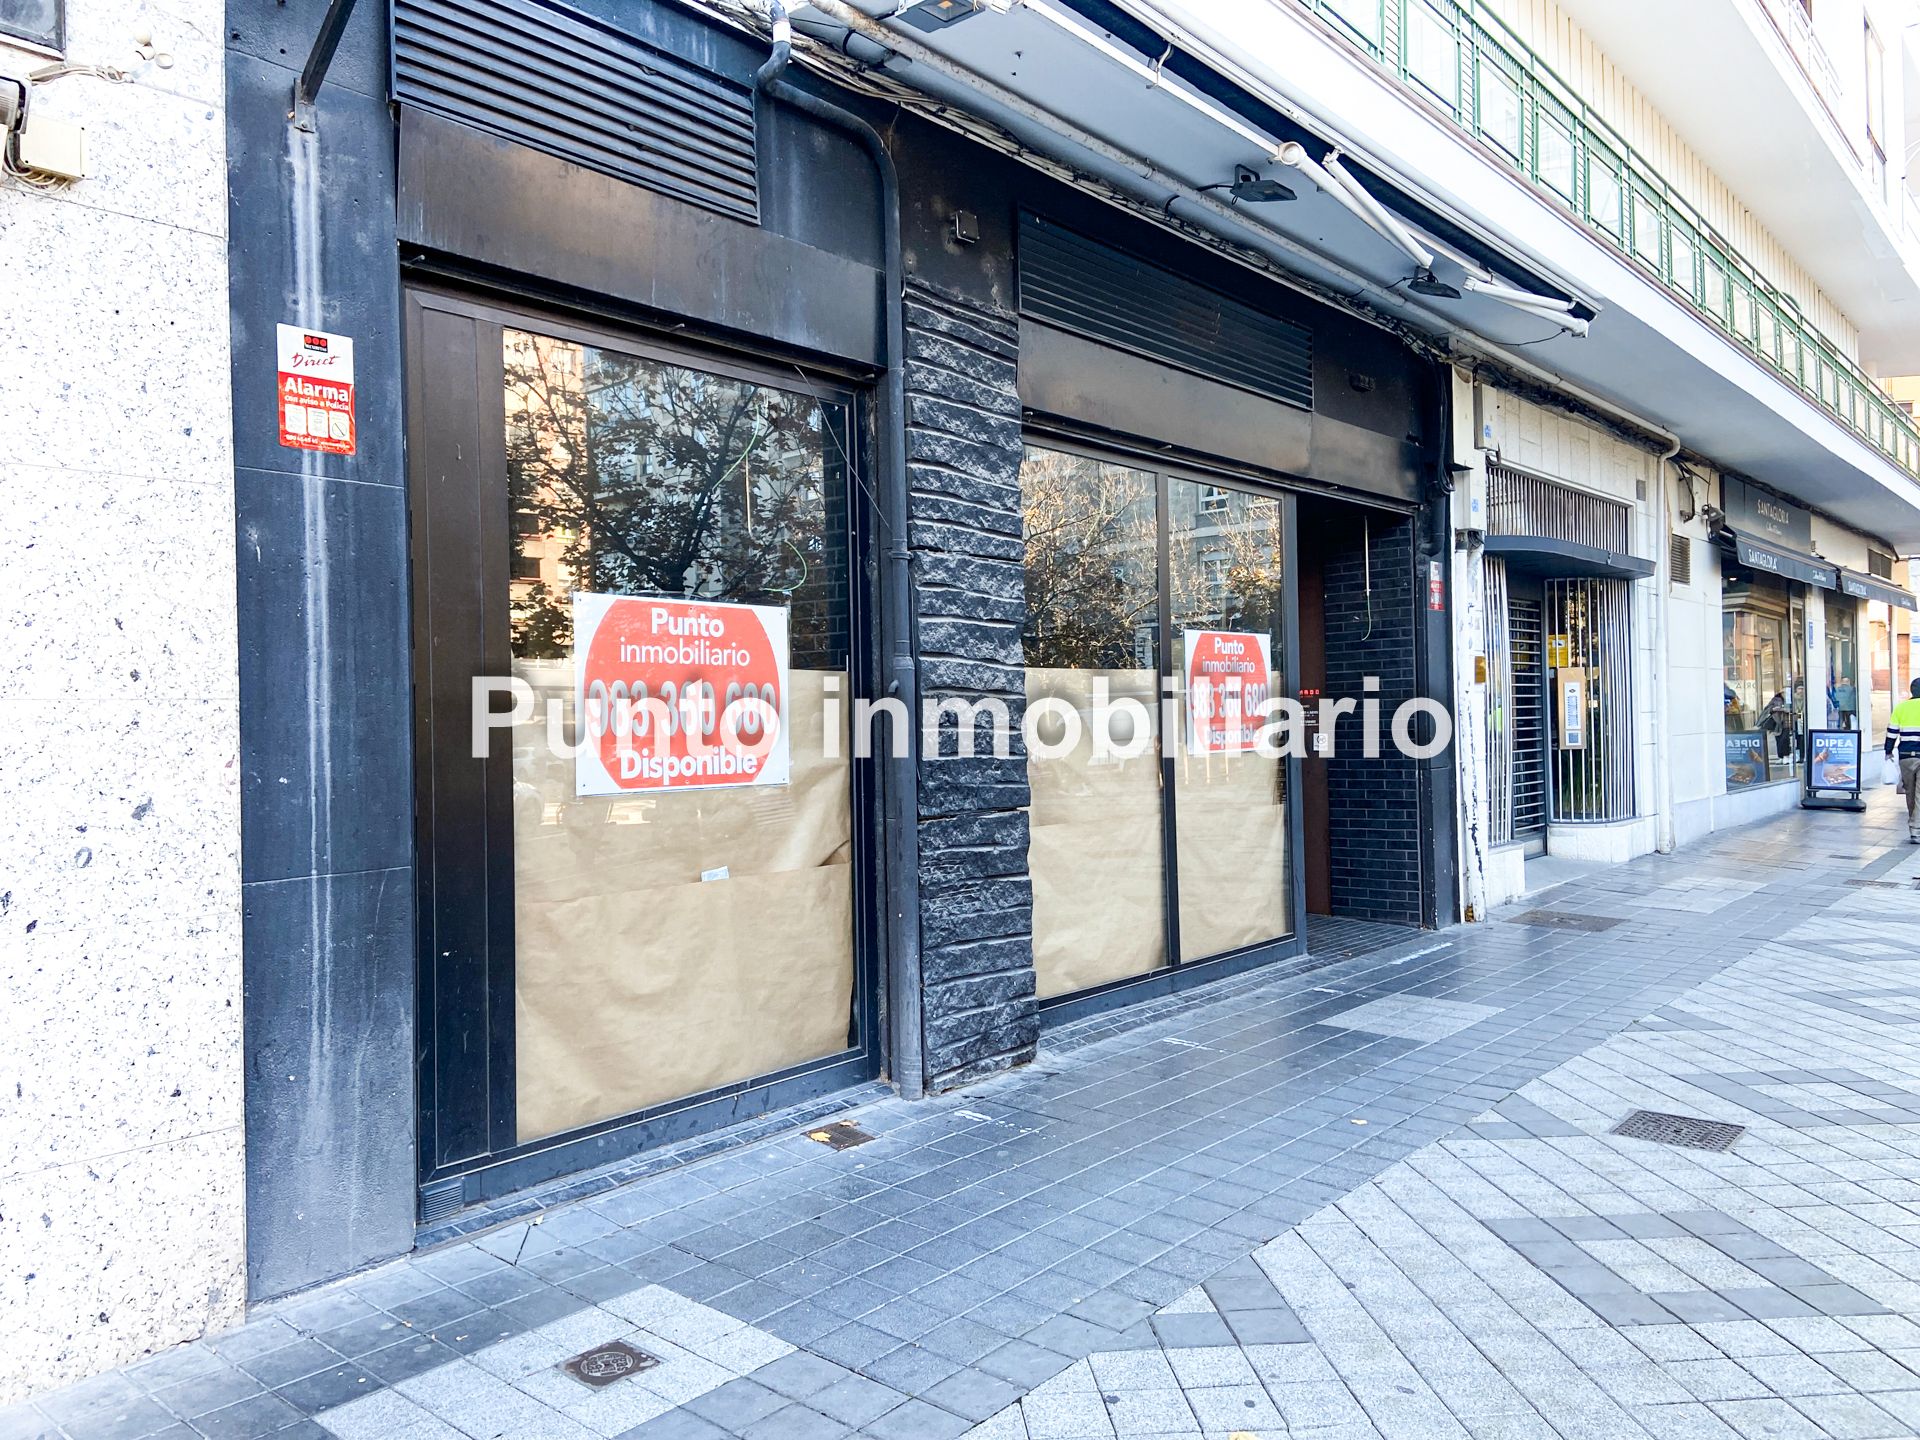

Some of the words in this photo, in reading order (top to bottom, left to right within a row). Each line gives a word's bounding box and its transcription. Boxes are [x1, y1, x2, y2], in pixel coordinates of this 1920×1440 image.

[291, 352, 341, 368] Direct
[284, 376, 349, 403] Alarma
[284, 395, 298, 403] con
[299, 397, 319, 406] aviso
[651, 607, 725, 638] Punto
[619, 636, 751, 667] inmobiliario
[1214, 636, 1245, 654] Punto
[1202, 655, 1256, 674] inmobiliario
[588, 679, 650, 738] 983
[725, 682, 777, 736] 680
[1815, 738, 1854, 747] DIPEA
[620, 745, 758, 785] Disponible
